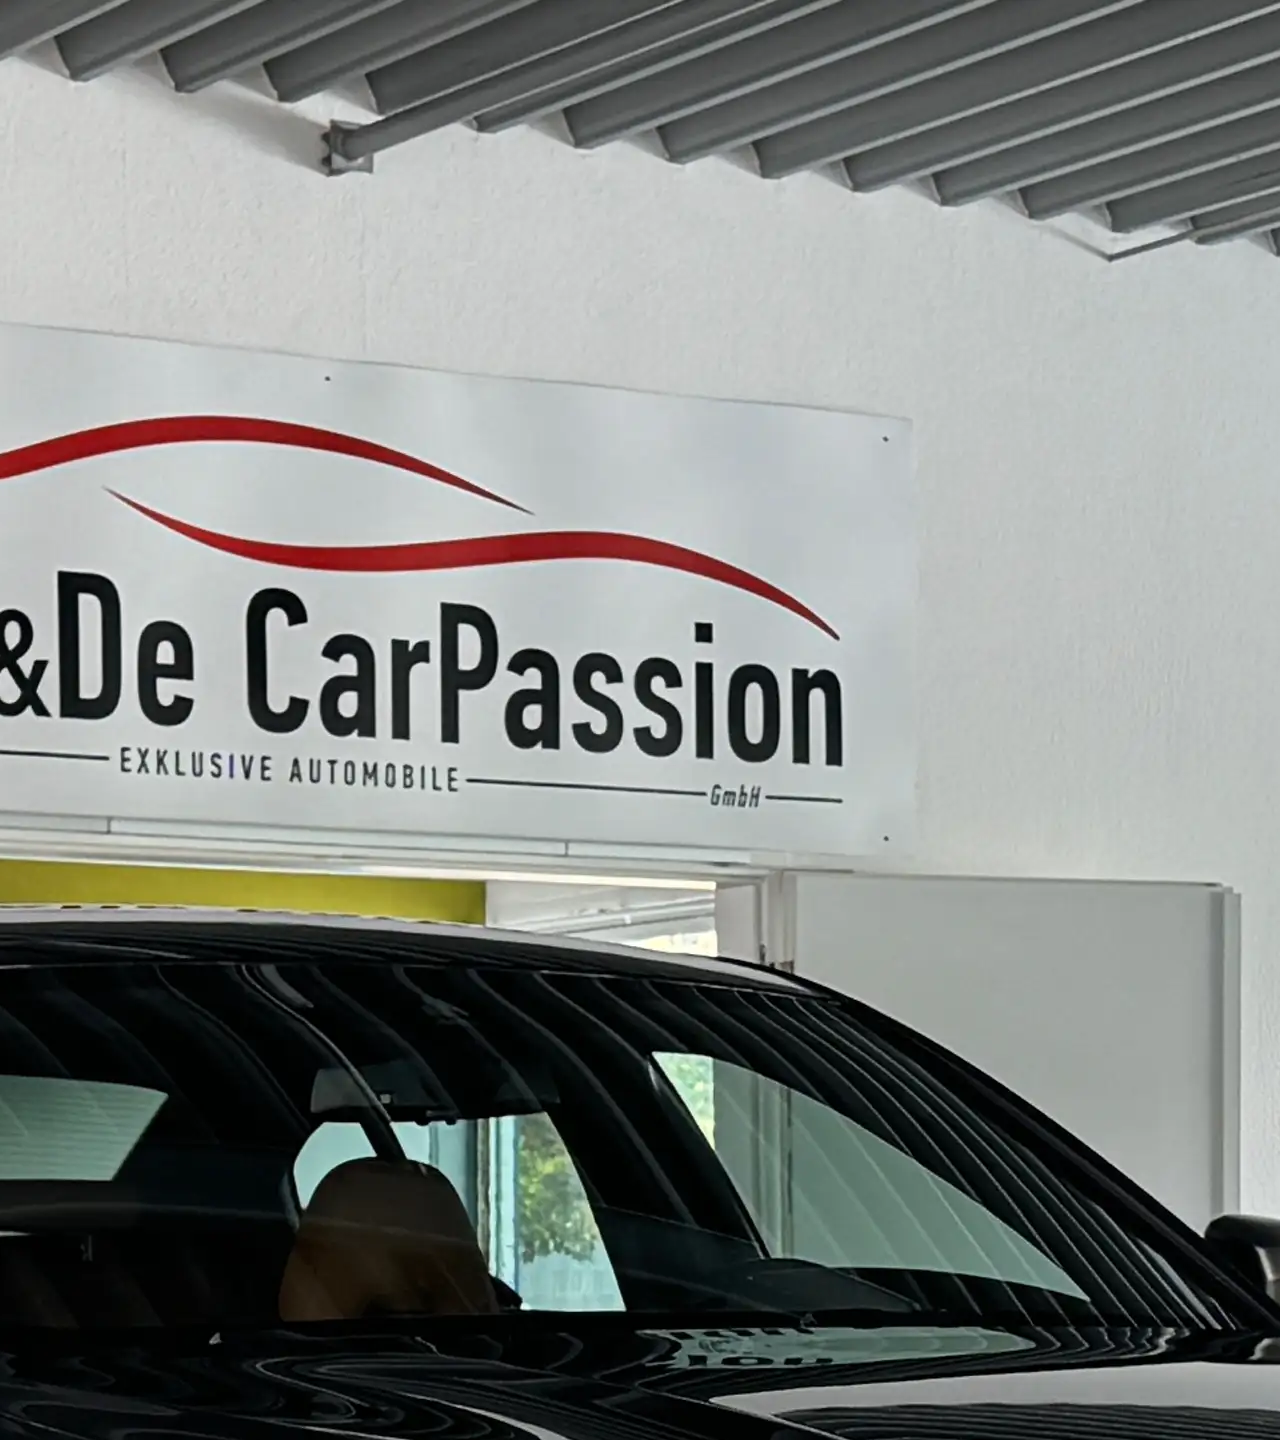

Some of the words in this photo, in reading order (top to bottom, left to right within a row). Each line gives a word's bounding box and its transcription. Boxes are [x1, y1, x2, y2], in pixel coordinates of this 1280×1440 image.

[246, 587, 843, 767] CarPassion
[120, 746, 272, 782] EXKLUSIVE
[289, 757, 459, 792] AUTOMOBILE
[710, 784, 762, 808] GmbH
